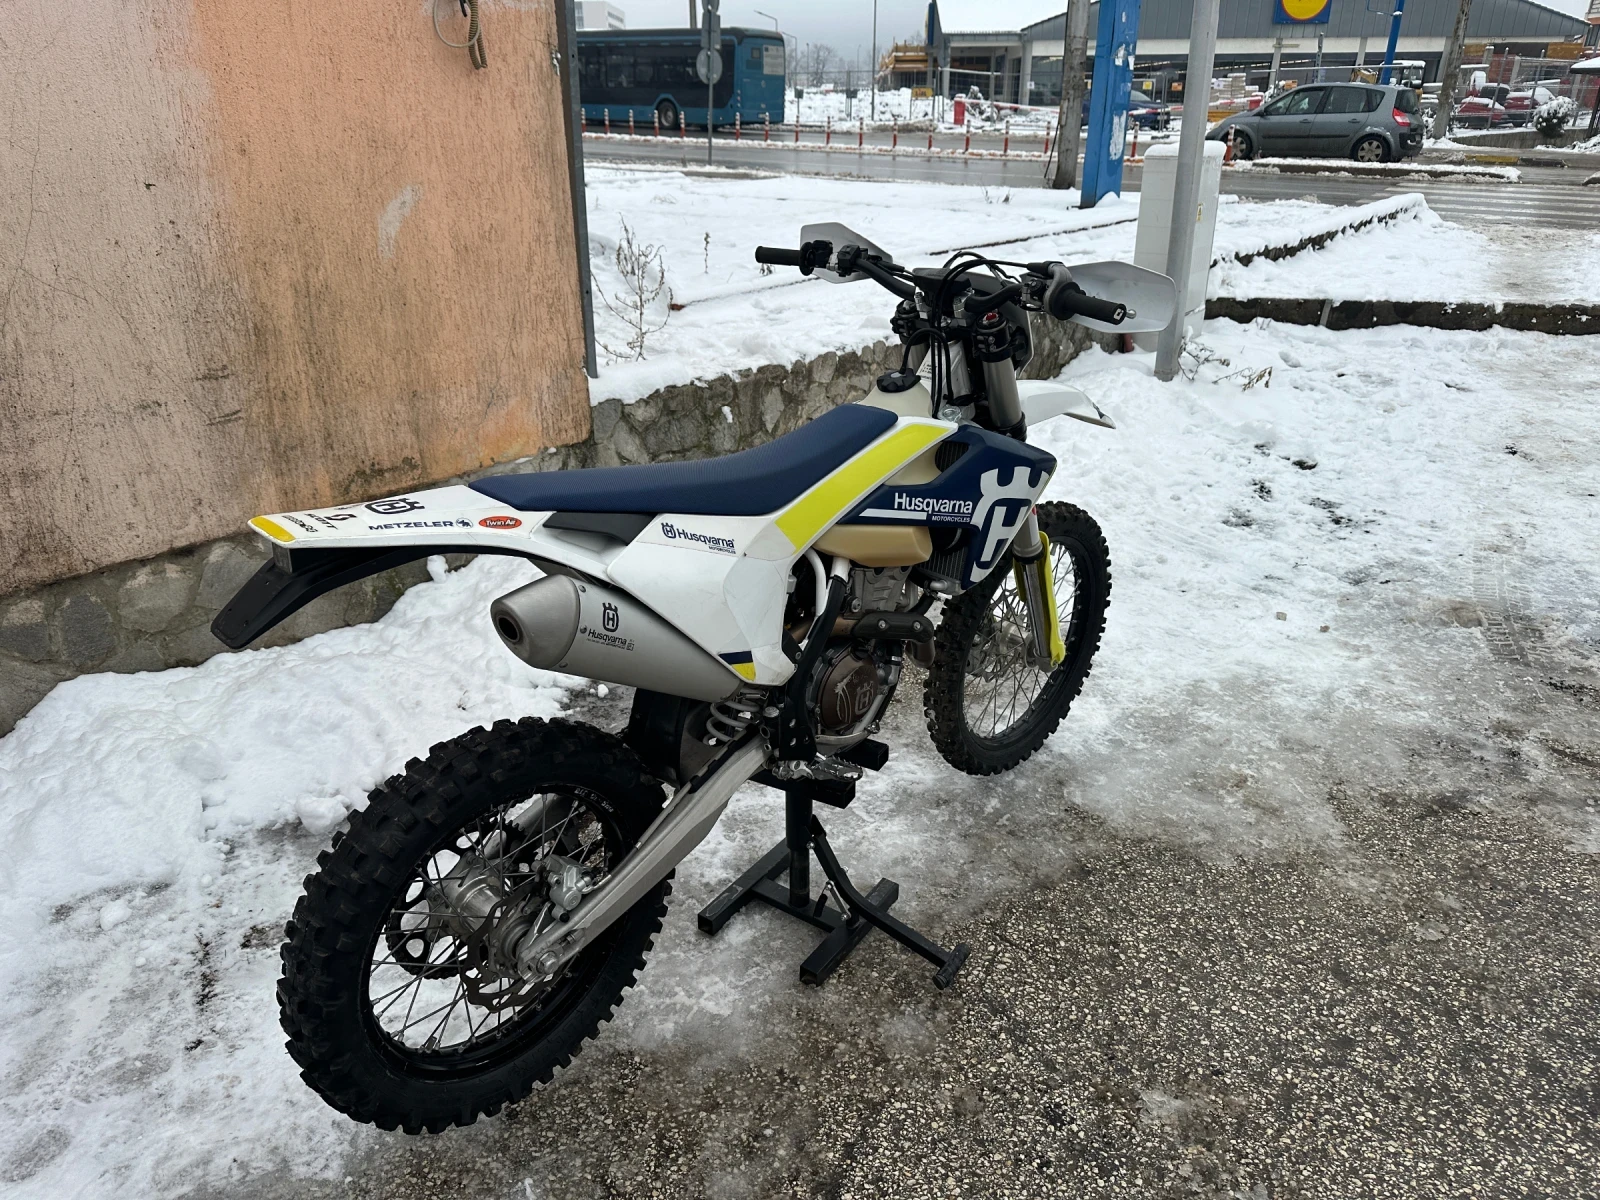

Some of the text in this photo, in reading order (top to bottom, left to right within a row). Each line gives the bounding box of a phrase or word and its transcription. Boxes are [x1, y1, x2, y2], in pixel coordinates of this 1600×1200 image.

[894, 492, 973, 515] Husqvarna
[368, 520, 454, 531] METZELER
[931, 515, 971, 523] MOTORCYCLES
[676, 528, 735, 549] Husqvarna
[587, 628, 628, 646] Husqvarna
